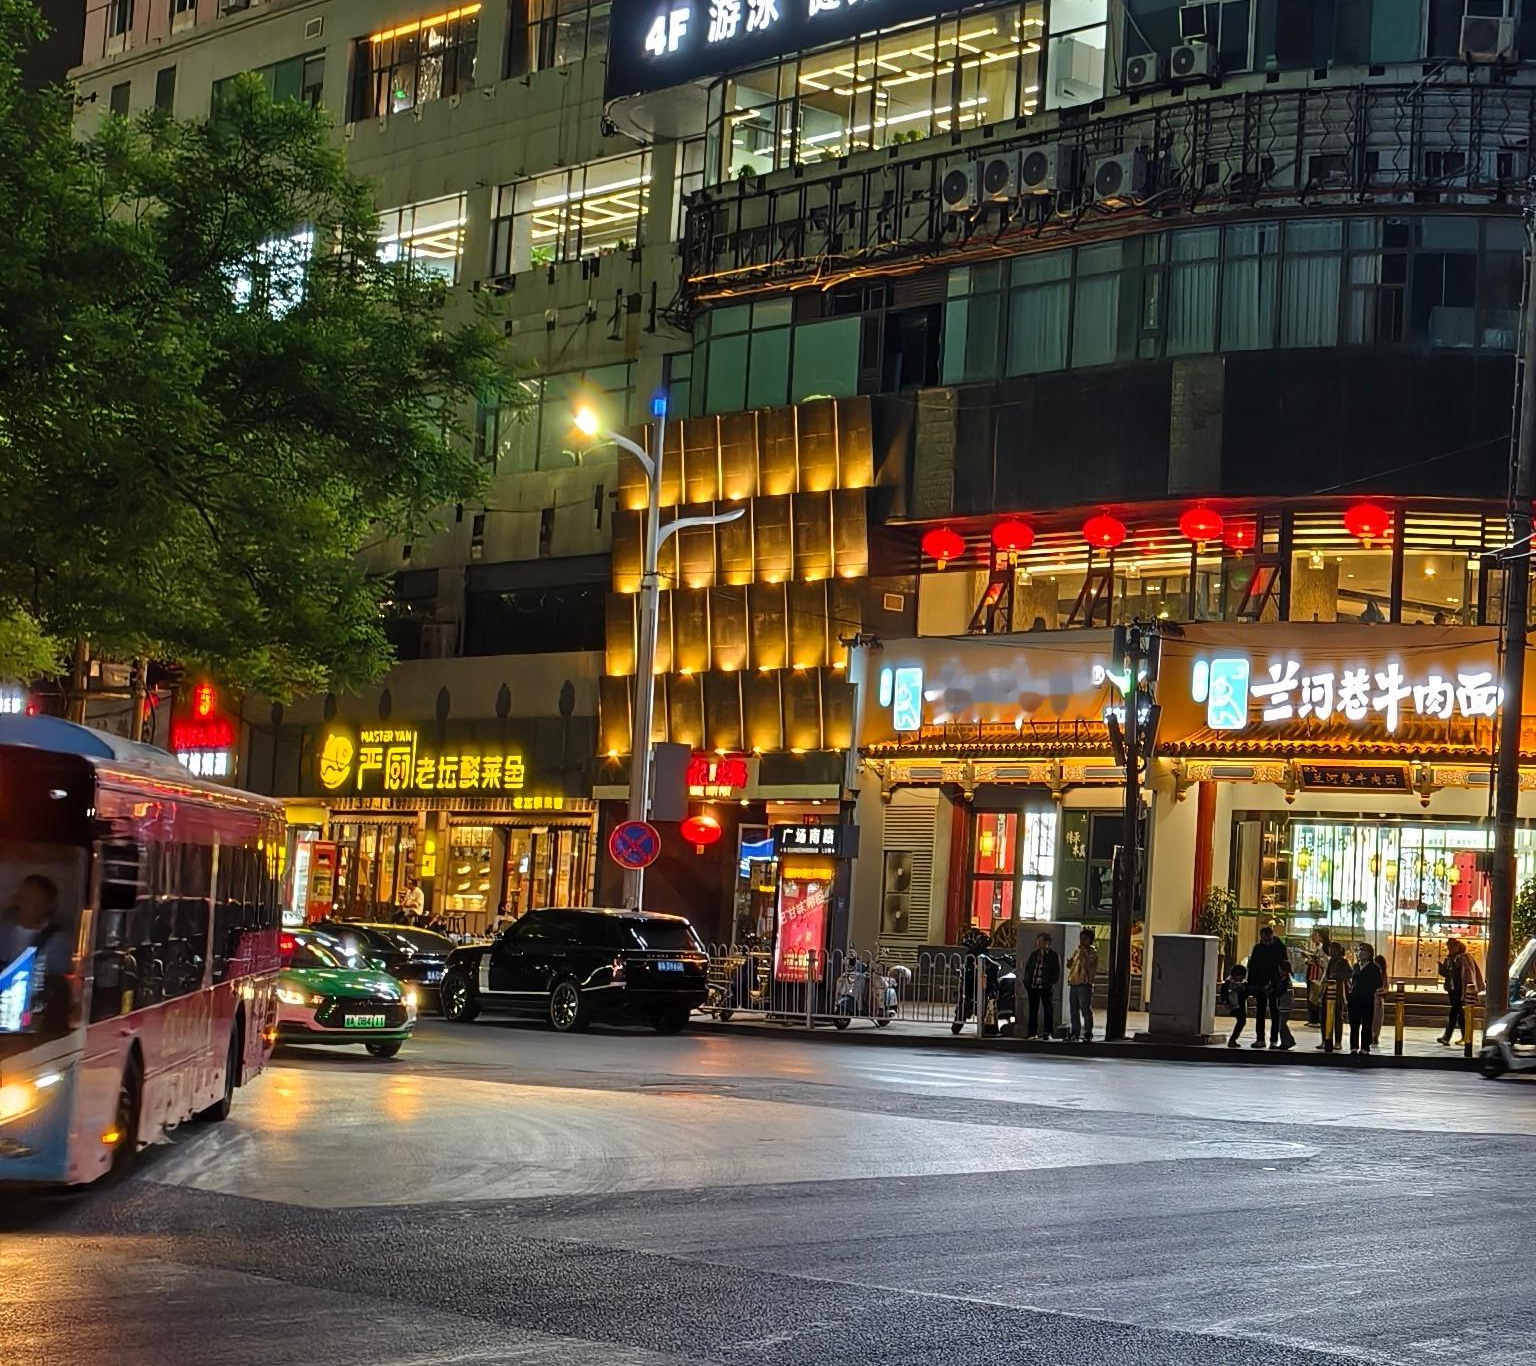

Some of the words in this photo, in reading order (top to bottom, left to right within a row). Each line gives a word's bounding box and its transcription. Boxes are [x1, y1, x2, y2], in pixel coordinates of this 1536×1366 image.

[644, 8, 690, 56] 4F
[1250, 661, 1505, 733] 兰河巷牛肉面
[361, 731, 393, 743] MASTER
[395, 731, 412, 742] YAN
[415, 756, 525, 789] 老坛酸菜鱼
[782, 828, 835, 845] 广场南路
